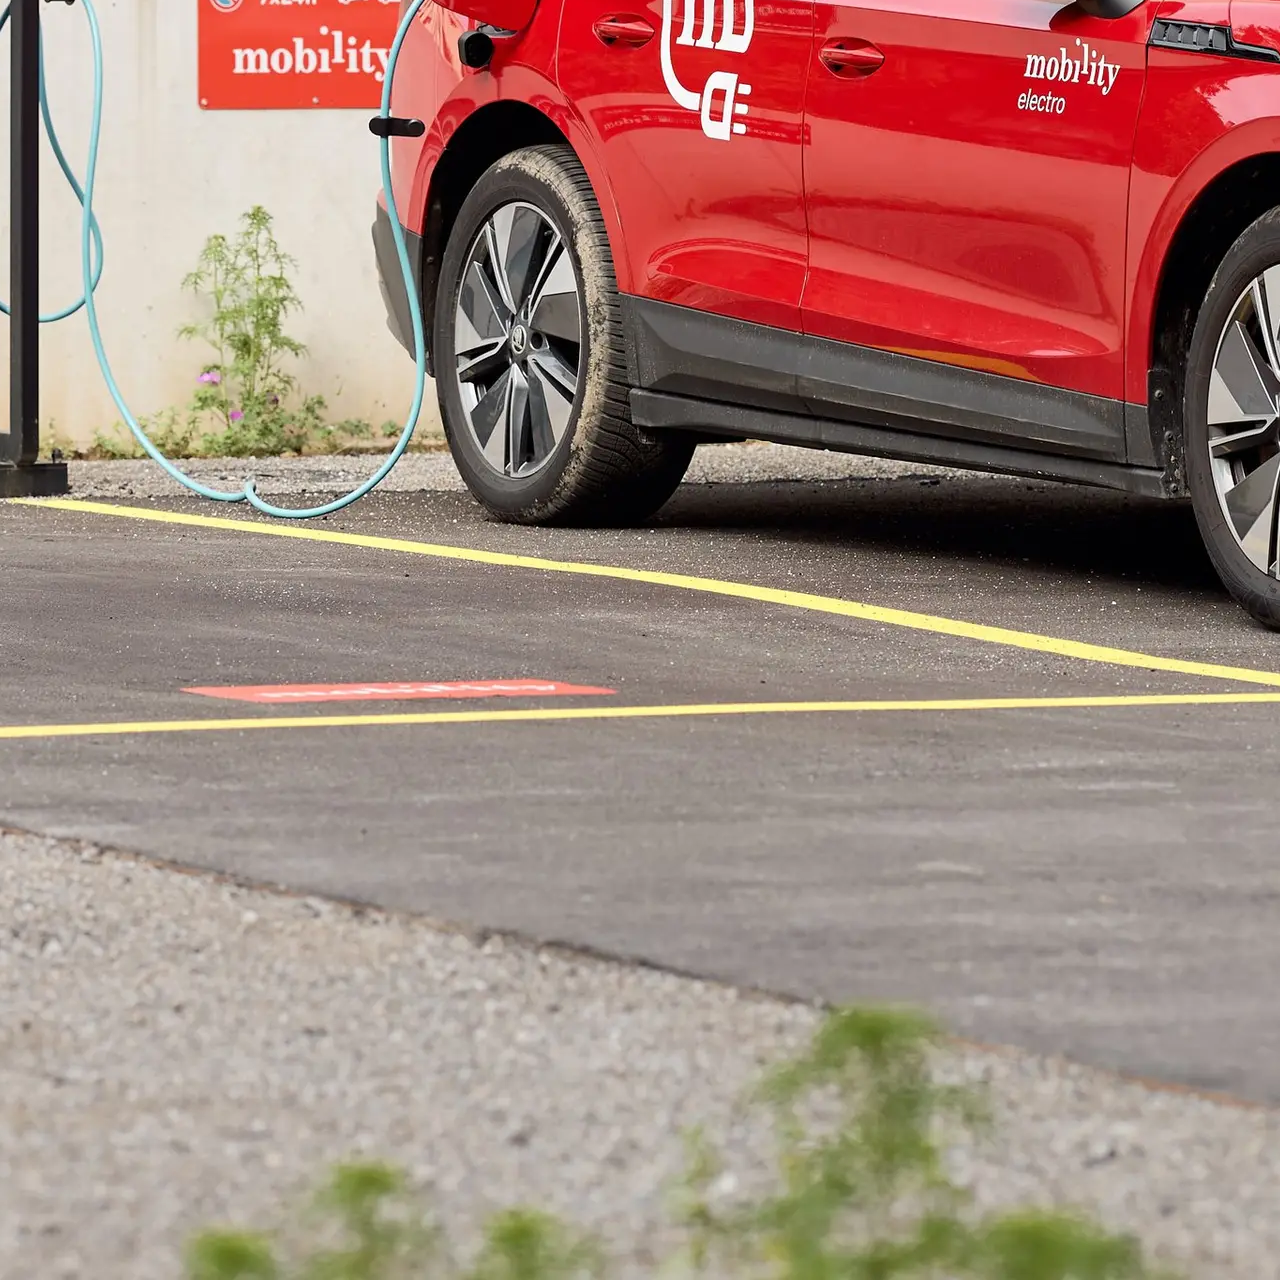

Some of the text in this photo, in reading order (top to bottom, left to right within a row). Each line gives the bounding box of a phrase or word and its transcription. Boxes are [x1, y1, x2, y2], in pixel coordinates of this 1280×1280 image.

[232, 25, 392, 82] mobility
[1024, 37, 1121, 95] mobility
[1017, 88, 1066, 114] electro
